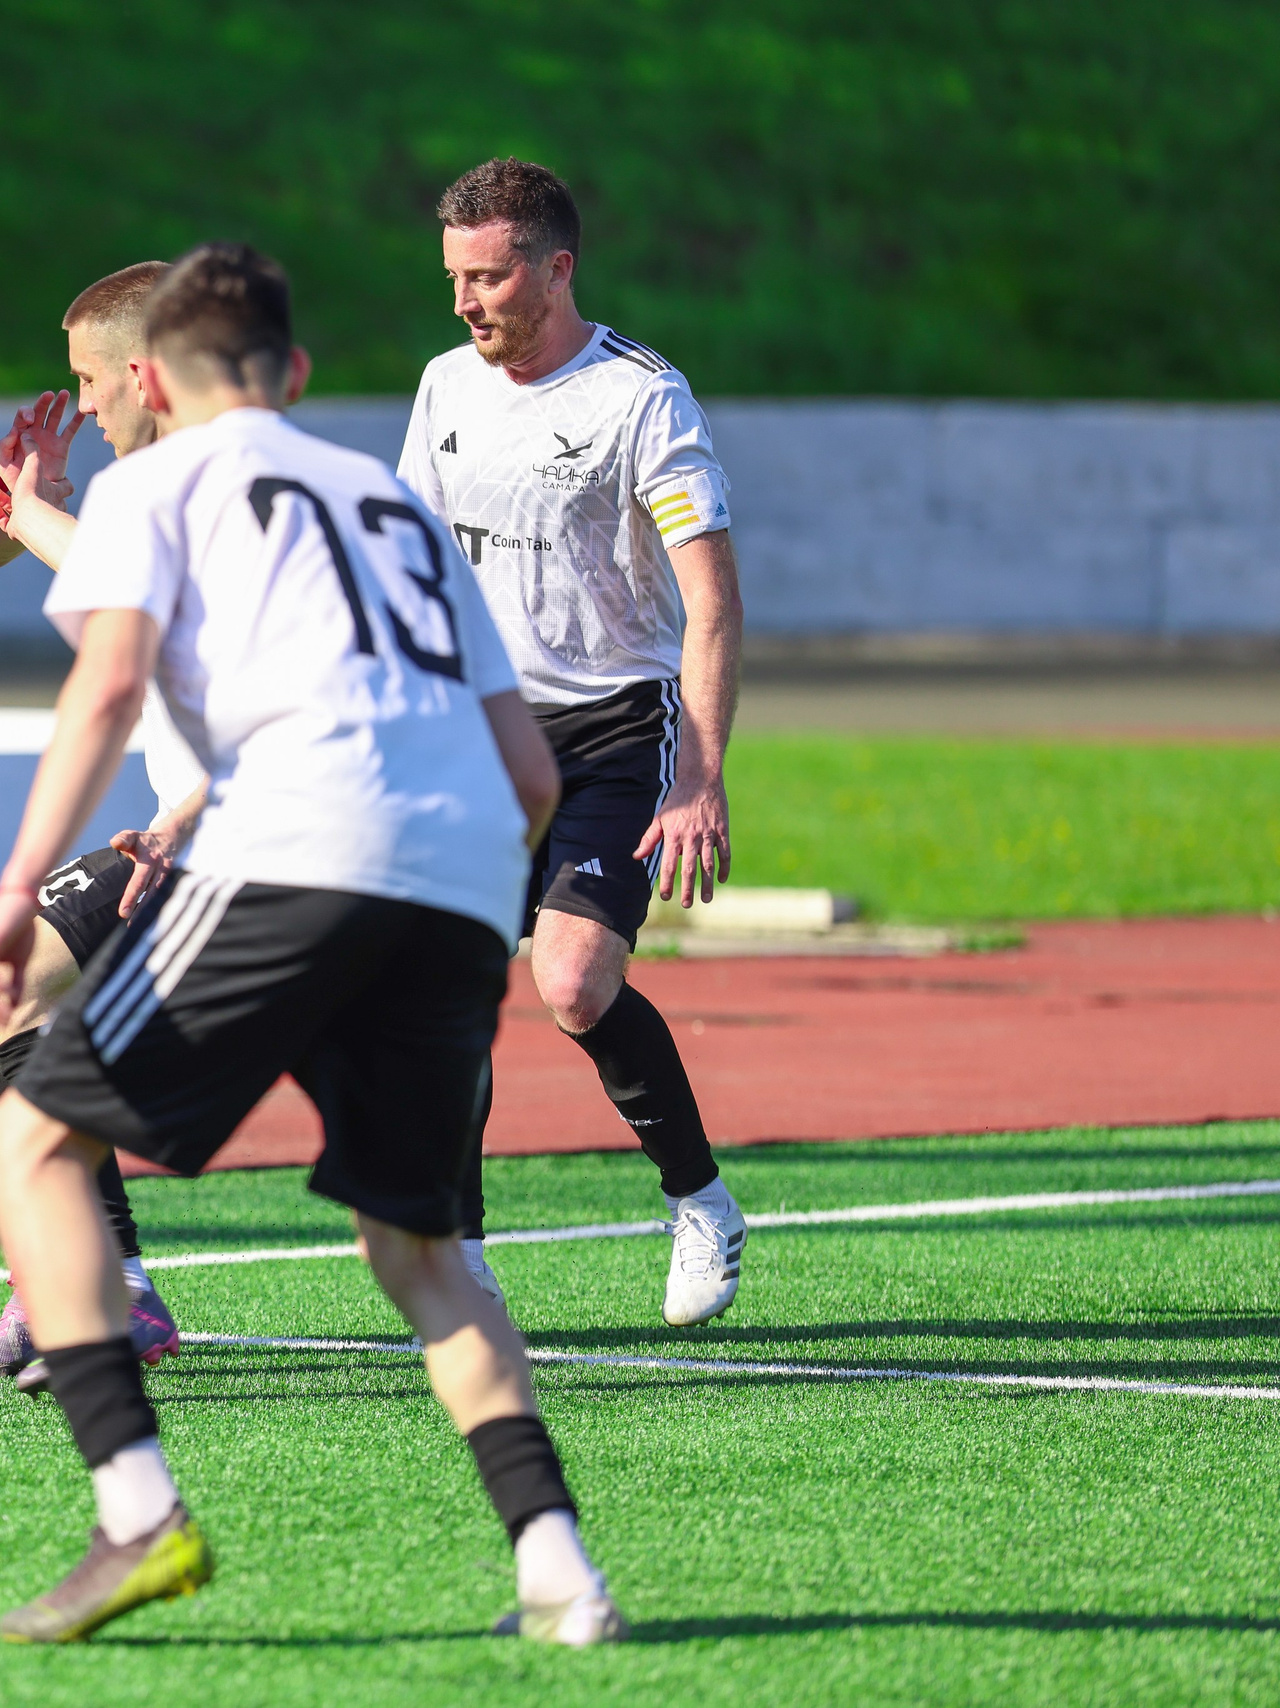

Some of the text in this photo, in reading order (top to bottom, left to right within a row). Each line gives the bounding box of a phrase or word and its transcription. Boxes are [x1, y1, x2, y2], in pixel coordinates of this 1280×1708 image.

[532, 463, 600, 484] ЧАЙКА
[542, 481, 586, 493] САМАРА
[491, 534, 553, 552] Coin Tab
